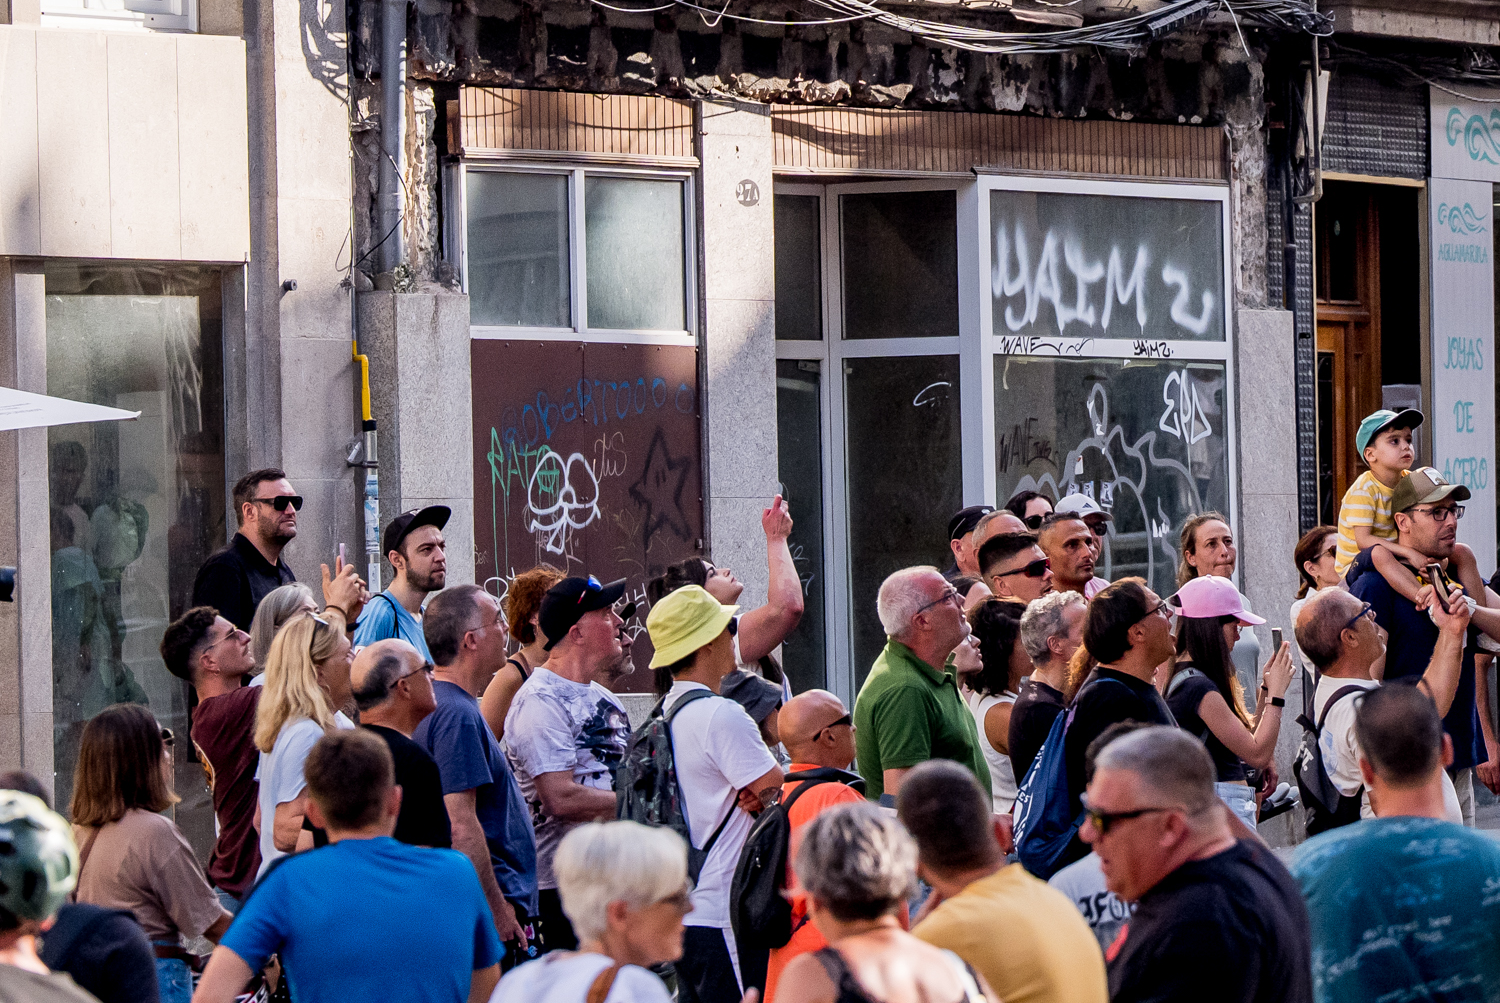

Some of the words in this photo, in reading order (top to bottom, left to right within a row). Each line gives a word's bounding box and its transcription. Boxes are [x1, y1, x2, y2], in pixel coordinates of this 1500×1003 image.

[736, 183, 759, 202] 27A
[1438, 242, 1489, 264] AGUAMARINA
[1443, 335, 1484, 371] JOYAS
[1453, 400, 1475, 434] DE
[1443, 456, 1488, 491] ACERO
